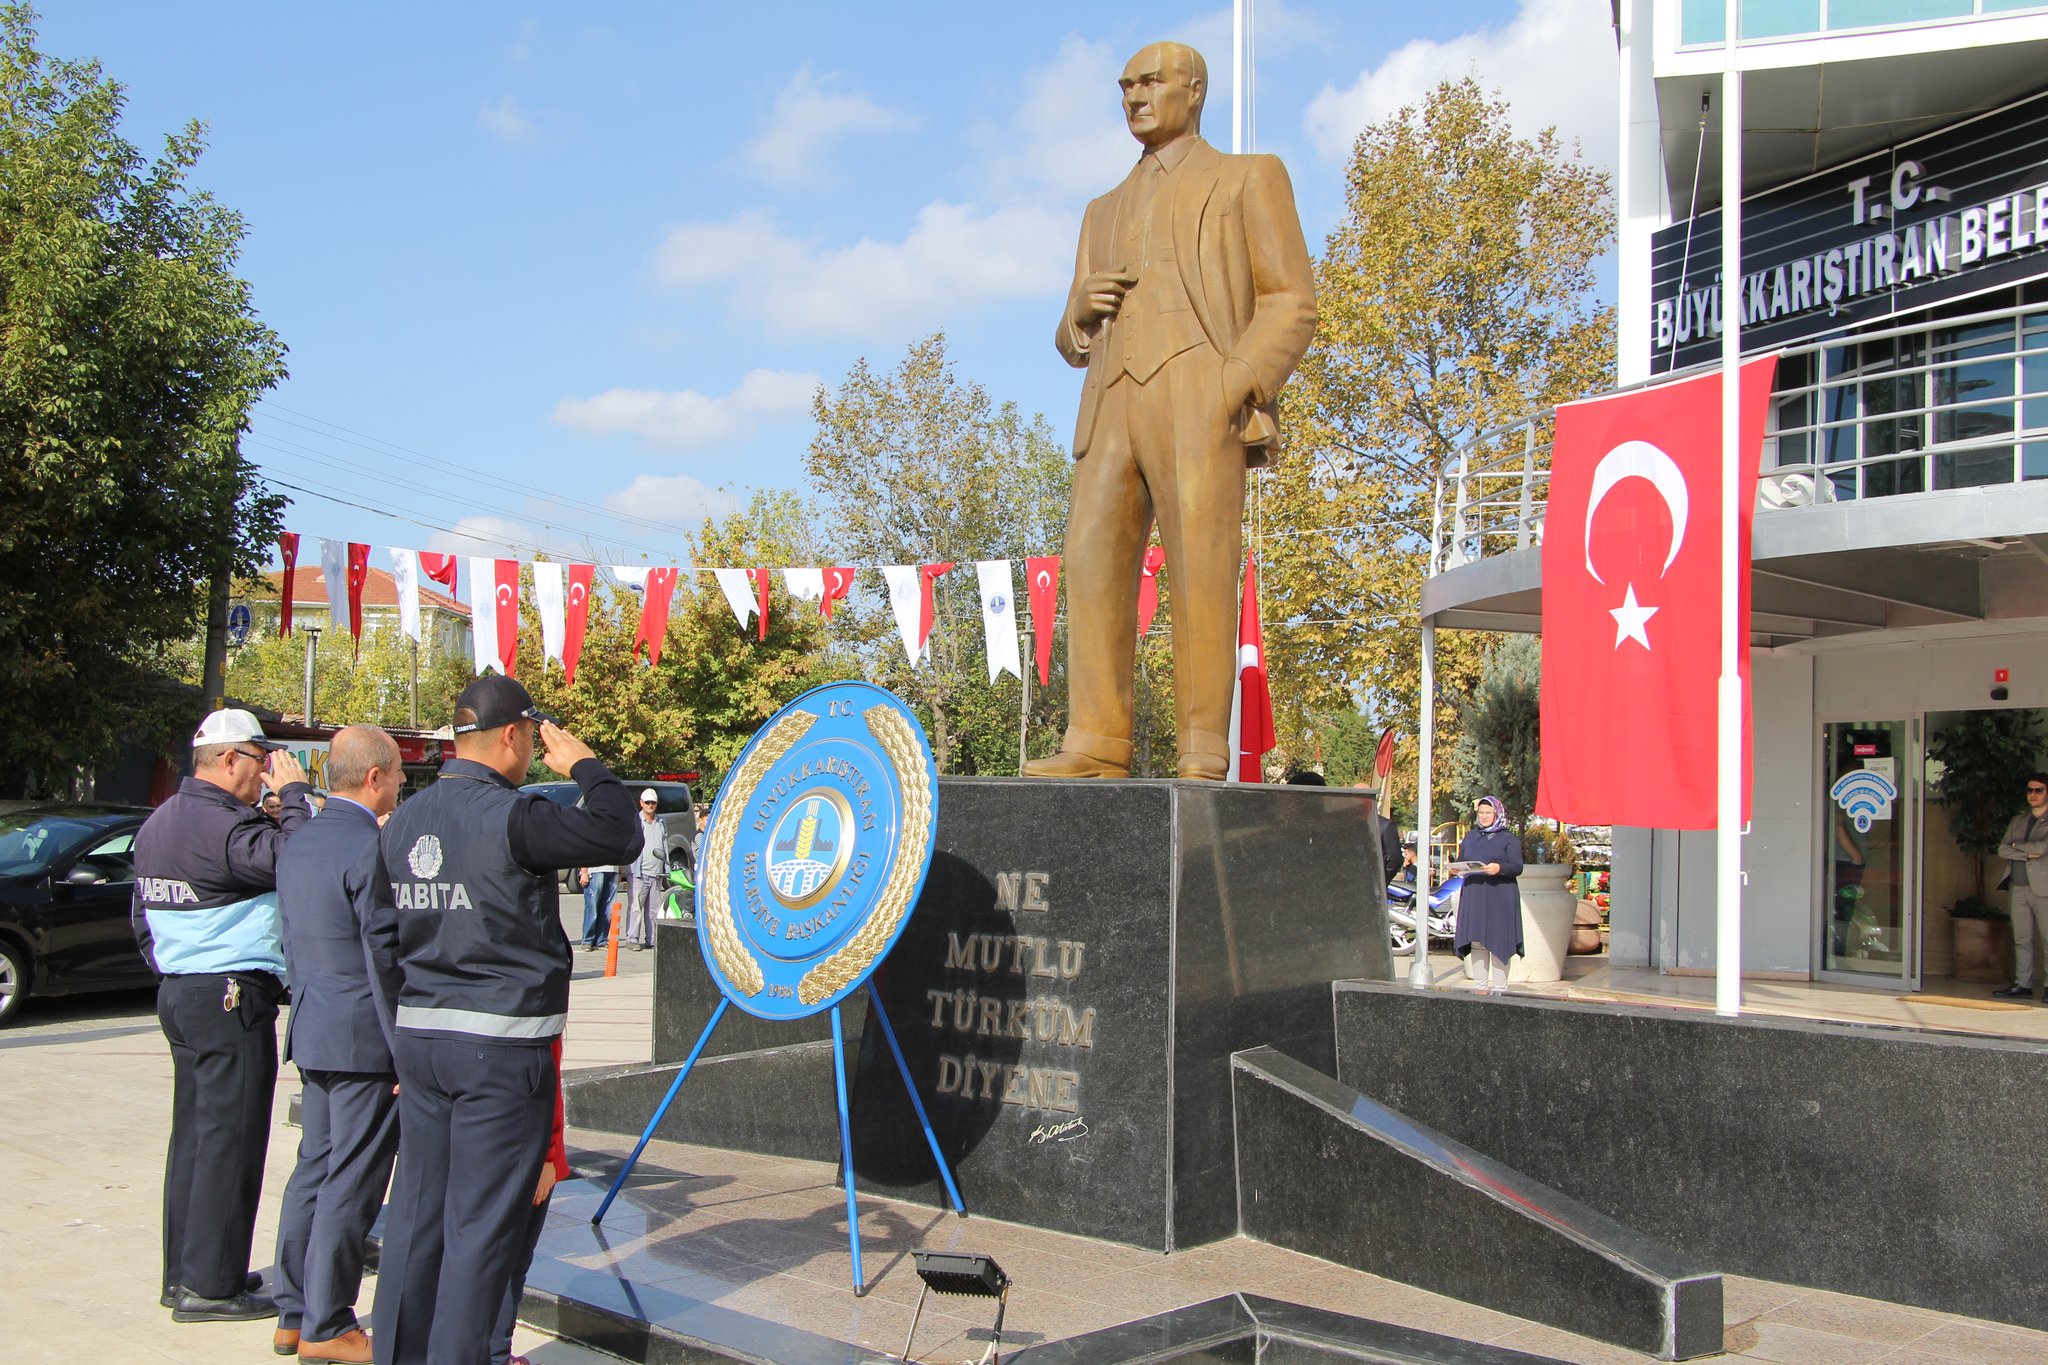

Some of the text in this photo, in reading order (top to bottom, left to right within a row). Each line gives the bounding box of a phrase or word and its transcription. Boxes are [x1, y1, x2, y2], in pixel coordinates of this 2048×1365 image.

[753, 756, 877, 833] BÜYÜKKARIŞTIRAN
[743, 851, 872, 940] BELEDİYE BAŞKANLIĞI
[994, 872, 1049, 912] NE
[944, 932, 1085, 980] MUTLU
[927, 987, 1096, 1048] TÜRKÜM
[936, 1053, 1078, 1113] DİYENE
